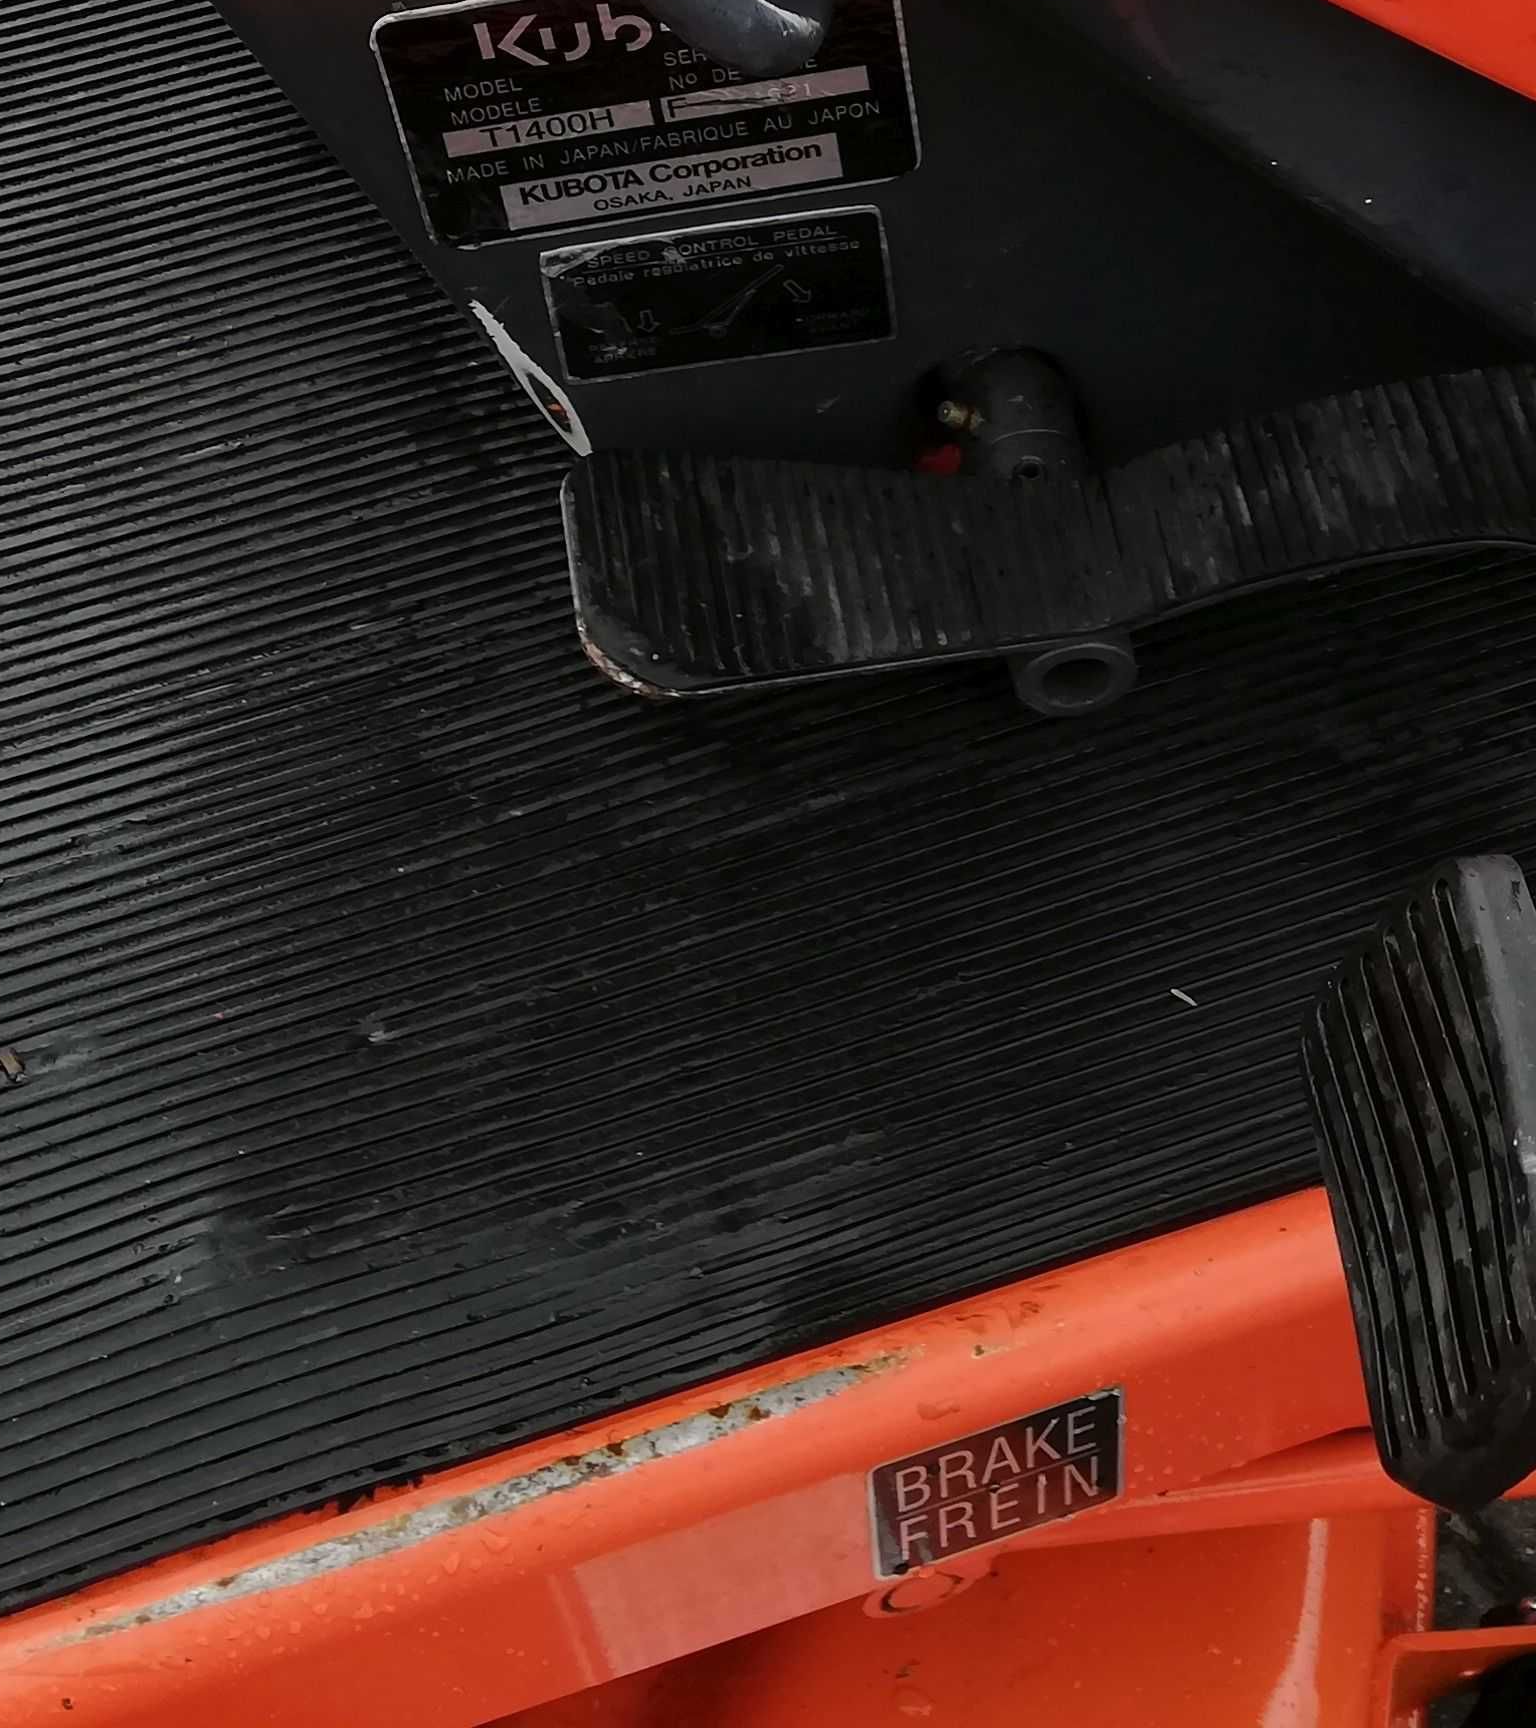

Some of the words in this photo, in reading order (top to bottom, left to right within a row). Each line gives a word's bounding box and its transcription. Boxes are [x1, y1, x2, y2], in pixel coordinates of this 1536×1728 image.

[443, 77, 522, 103] MODEL
[449, 97, 542, 125] MODELE
[479, 109, 615, 148] T1400H
[445, 160, 509, 184] MADE
[522, 154, 546, 171] IN
[762, 113, 794, 132] AU
[806, 100, 881, 125] JAPON
[518, 168, 643, 205] KUBOTA
[648, 139, 823, 186] Corporation
[682, 175, 752, 197] JAPAN
[772, 223, 837, 243] PEDAL
[896, 1406, 1097, 1513] BRAKE
[899, 1457, 1099, 1562] FREIN
